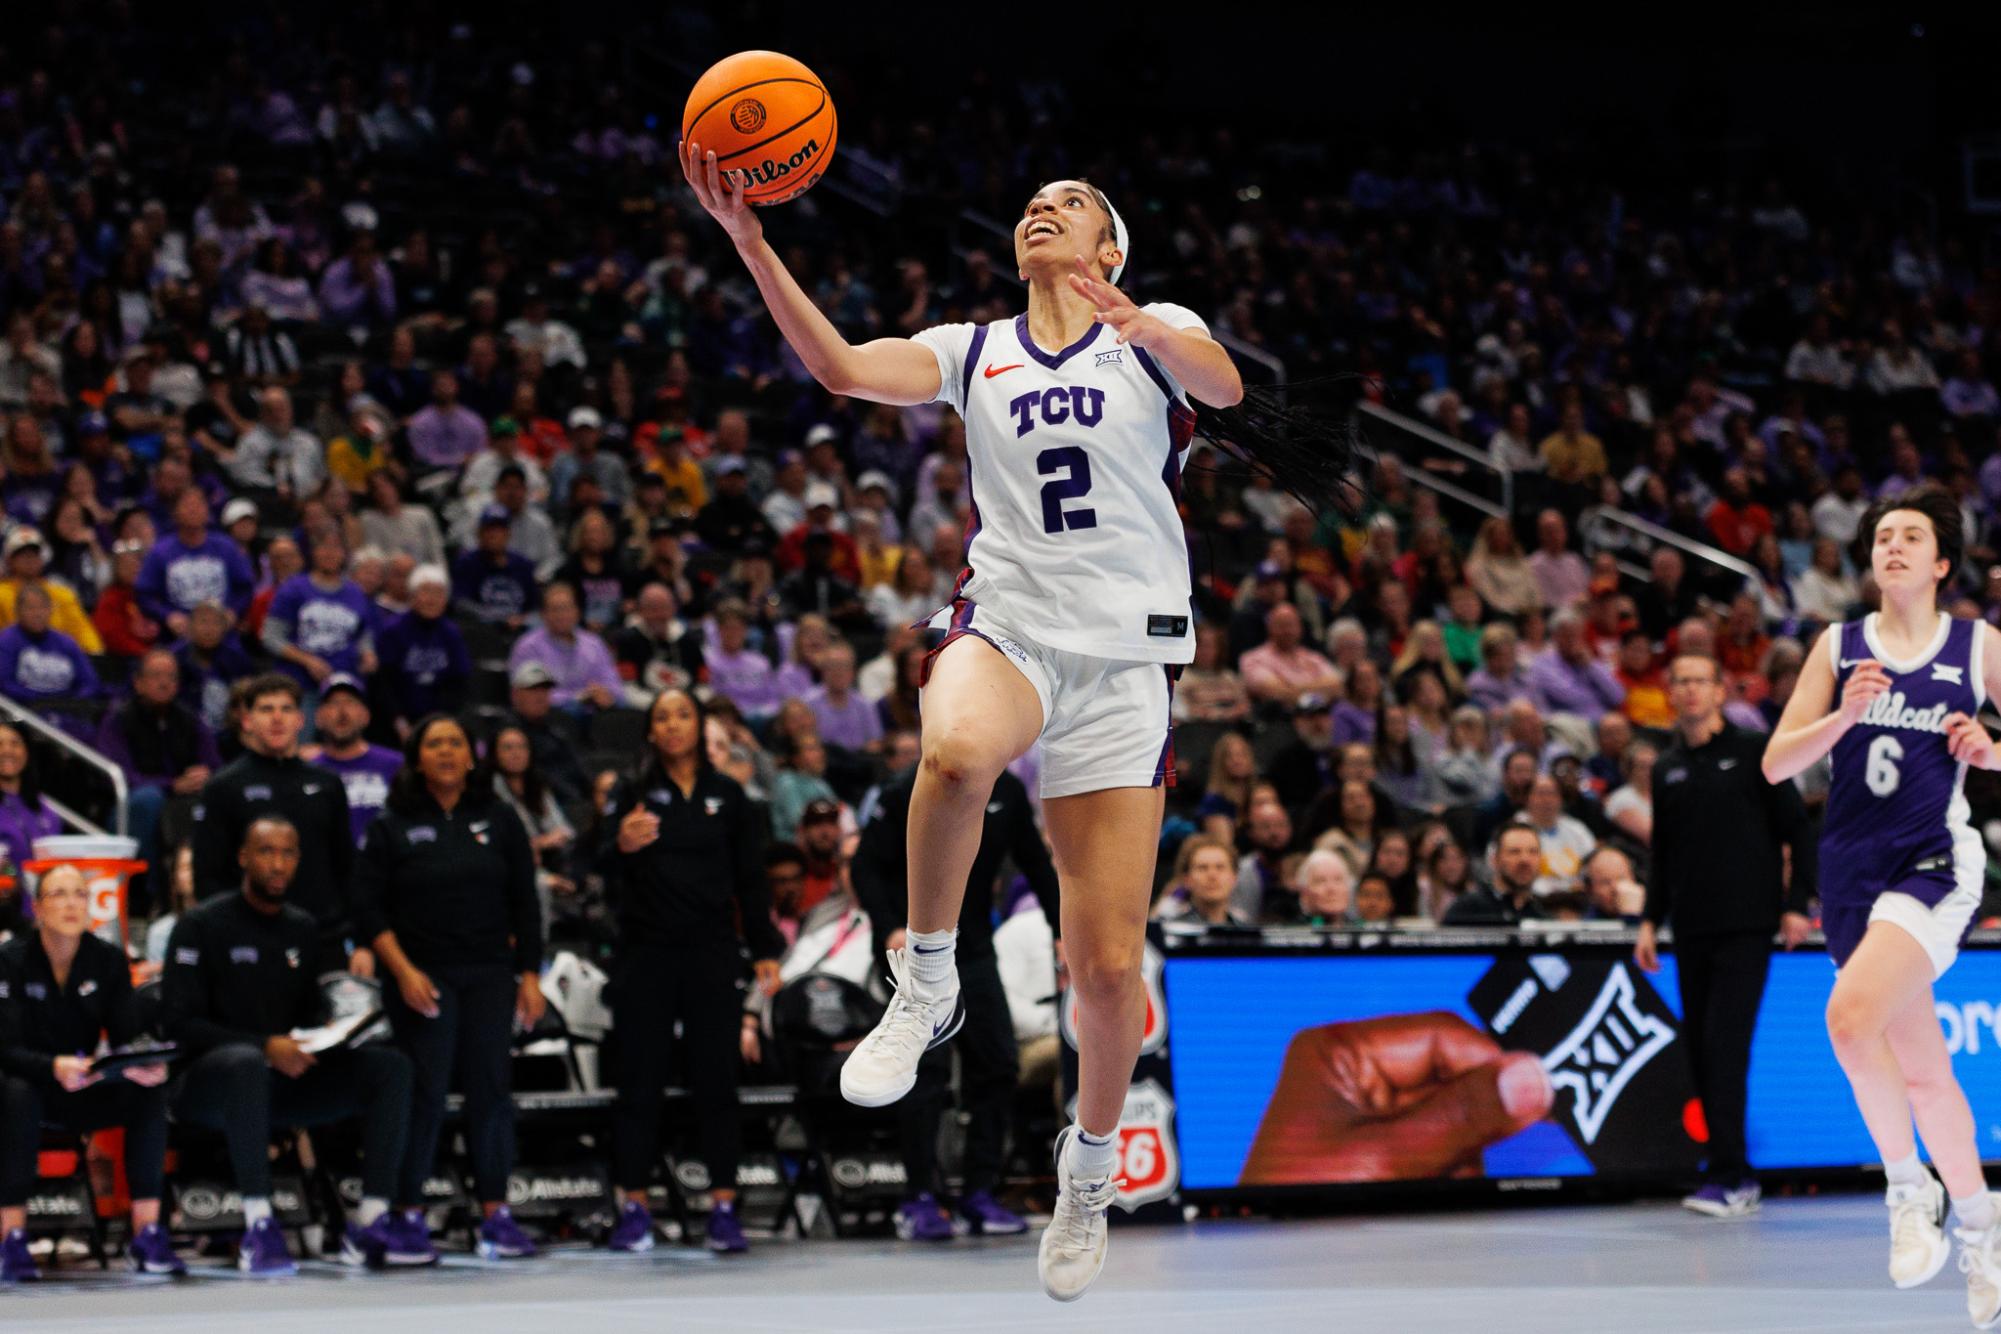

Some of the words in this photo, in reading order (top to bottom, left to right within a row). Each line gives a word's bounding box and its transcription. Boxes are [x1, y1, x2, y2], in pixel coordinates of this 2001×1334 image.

[719, 138, 820, 189] Wilson
[1010, 385, 1105, 438] TCU
[1036, 446, 1097, 534] 2
[1859, 691, 1949, 734] ildcat
[1865, 734, 1904, 797] 6
[26, 1195, 81, 1215] state
